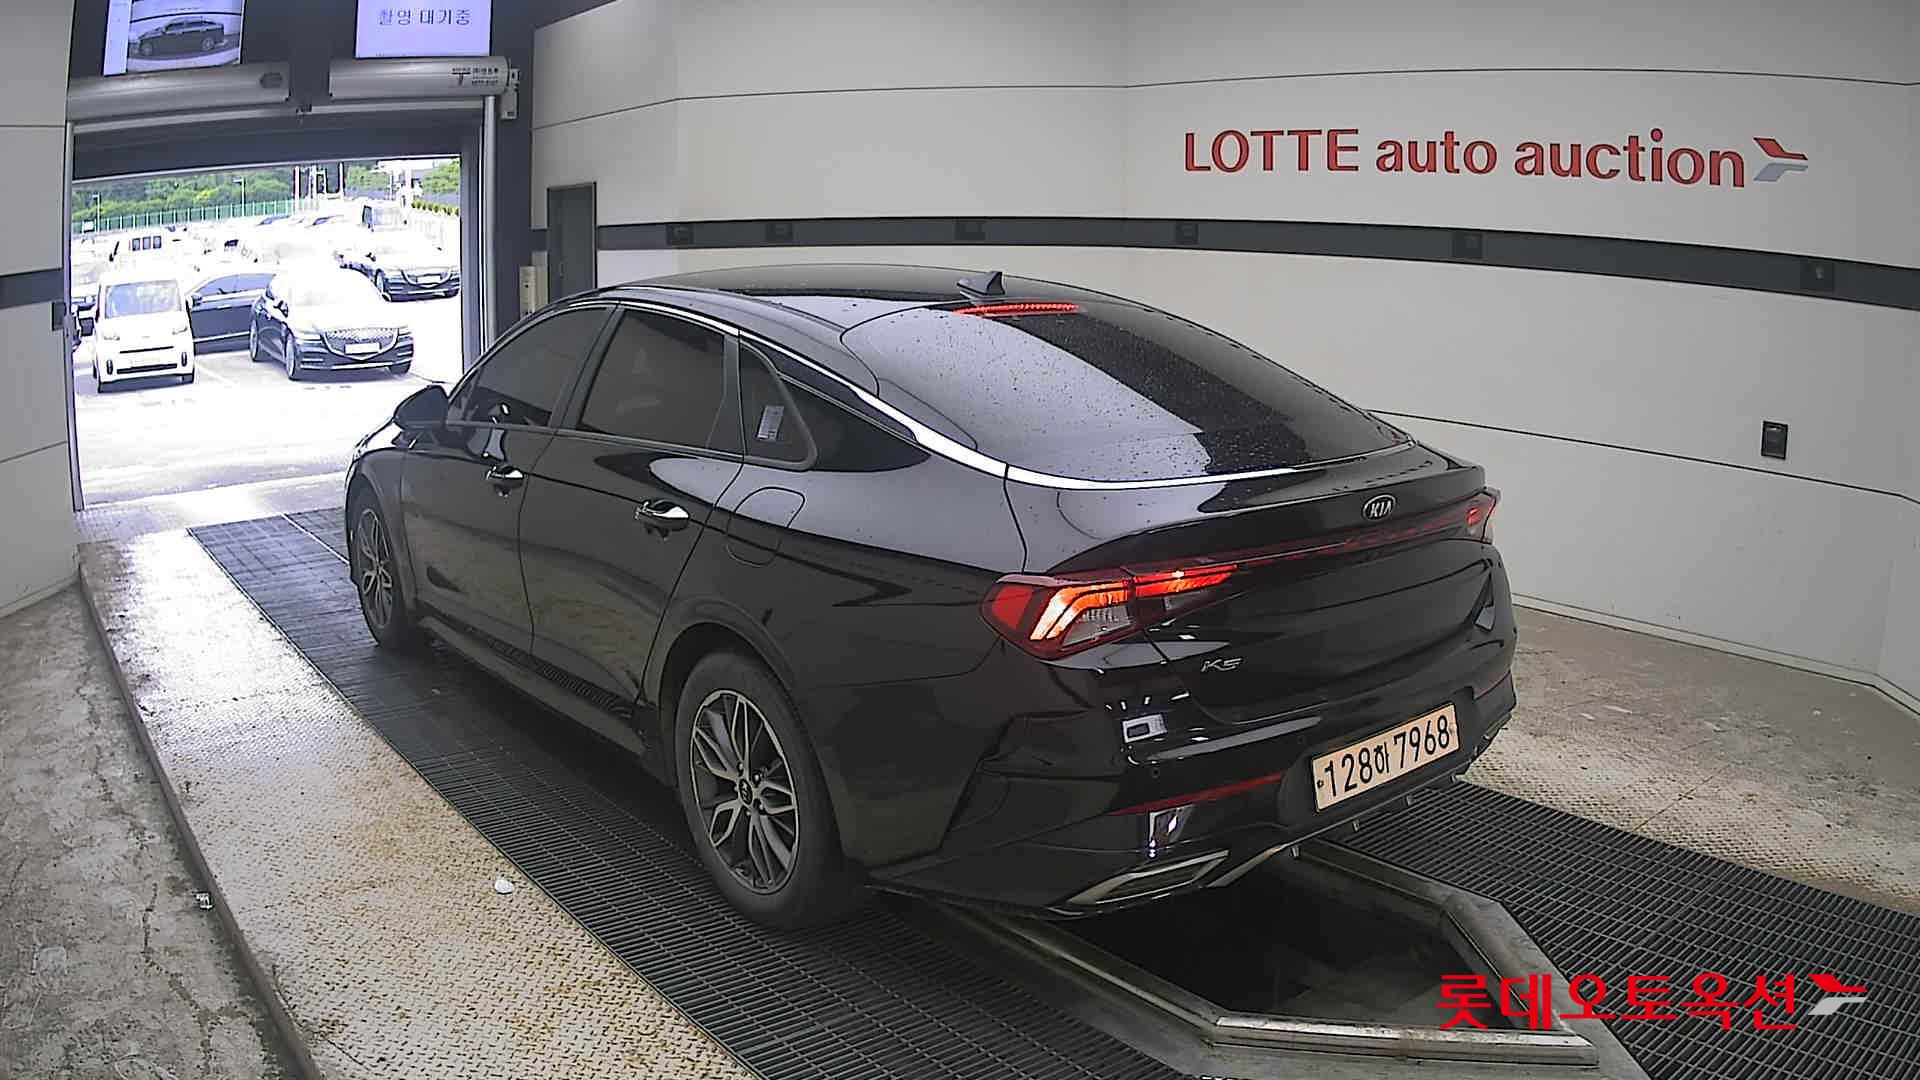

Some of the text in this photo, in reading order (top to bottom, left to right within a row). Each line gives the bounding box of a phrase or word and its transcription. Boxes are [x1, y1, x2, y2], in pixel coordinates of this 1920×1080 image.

[419, 8, 471, 26] 대기중
[1184, 128, 1745, 188] LOTTE auto auction
[1200, 657, 1243, 673] K5
[1392, 714, 1450, 769] 7968
